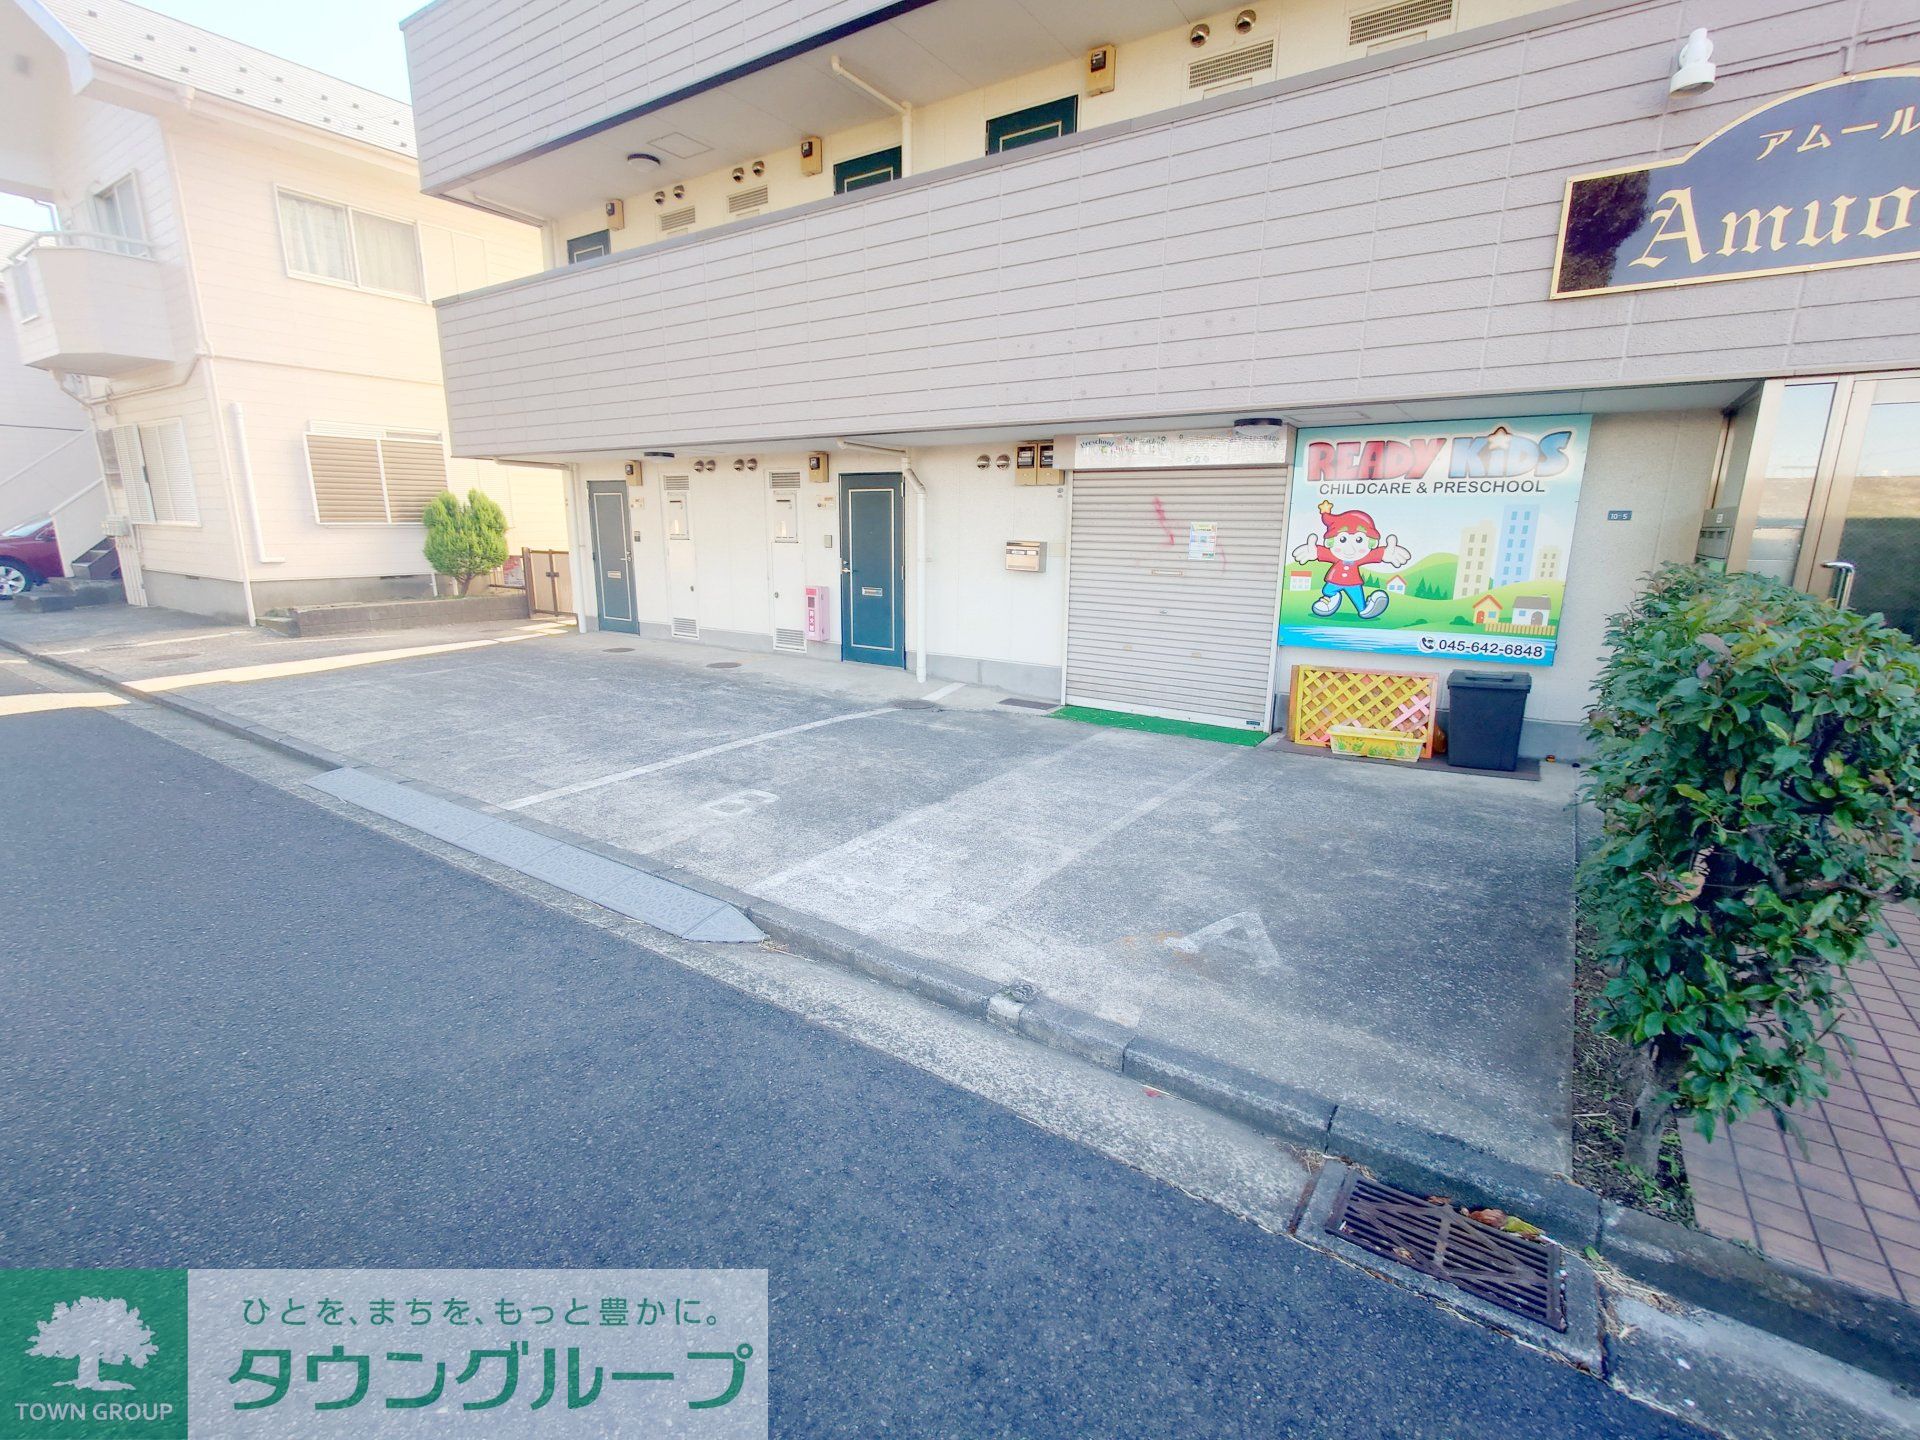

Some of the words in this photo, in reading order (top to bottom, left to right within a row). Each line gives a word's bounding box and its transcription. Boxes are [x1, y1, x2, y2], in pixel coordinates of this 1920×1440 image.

[1756, 106, 1920, 160] アムール
[1628, 186, 1920, 268] Amuo
[1307, 438, 1447, 482] READY
[1319, 481, 1412, 496] CHILDCARE
[1416, 480, 1429, 494] &
[1433, 479, 1546, 494] PRESCHOOL
[1438, 638, 1543, 659] 045-642-6848
